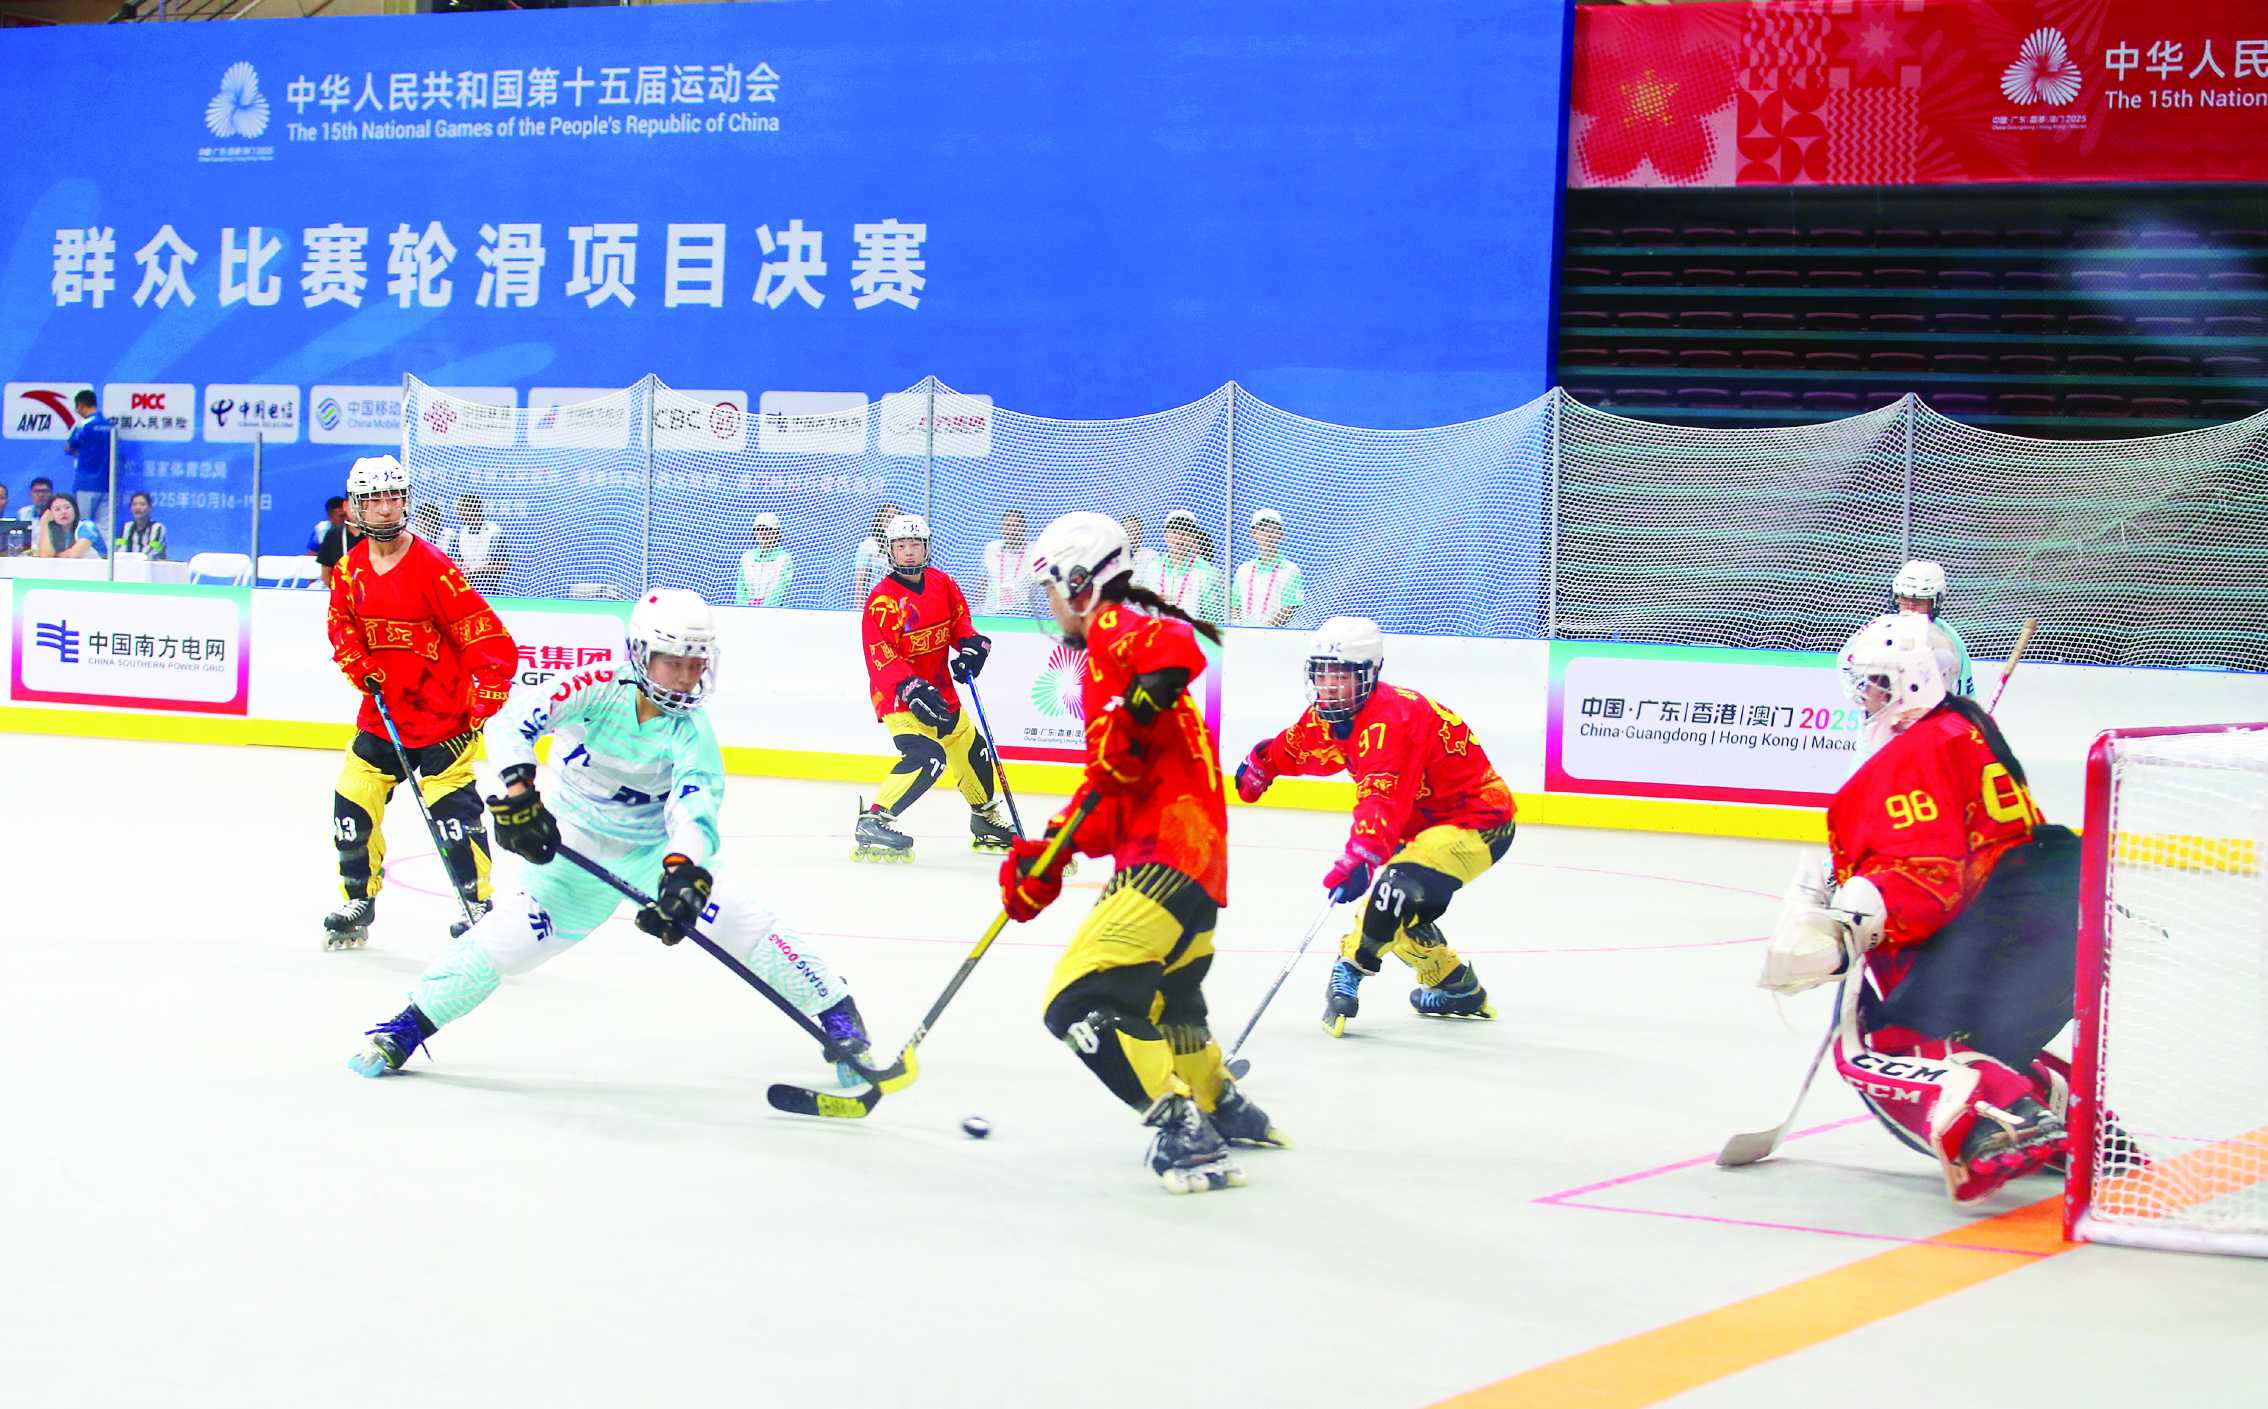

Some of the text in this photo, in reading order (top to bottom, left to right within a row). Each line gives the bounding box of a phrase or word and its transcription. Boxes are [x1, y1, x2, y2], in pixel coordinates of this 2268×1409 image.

[286, 62, 780, 115] 中华人民共和国第十五届运动会
[2105, 90, 2142, 109] The
[2150, 89, 2193, 108] 15th
[286, 112, 780, 141] The 15th National Games of the People's Republic of China
[51, 218, 927, 310] 群众比赛轮滑项目决赛
[131, 393, 165, 409] PICC
[238, 400, 293, 420] 中国电信
[348, 399, 400, 416] 中国移动
[17, 413, 52, 432] ANTA
[109, 414, 188, 430] 中国人民保险
[348, 418, 371, 429] China
[653, 408, 701, 431] CBC
[151, 491, 273, 511] 025年10月16-1日
[88, 631, 225, 662] 中国南方电网
[88, 657, 225, 672] CHINA SOUTHERN POWER GRID
[1799, 707, 1861, 731] 2025
[1719, 731, 1758, 748] Hong
[1762, 732, 1799, 750] Kong
[1885, 789, 1939, 829] 98
[335, 816, 358, 842] 13
[436, 818, 464, 842] 13
[1374, 881, 1406, 918] 97
[1851, 1053, 1949, 1082] CCM
[1850, 1080, 1922, 1104] CCM
